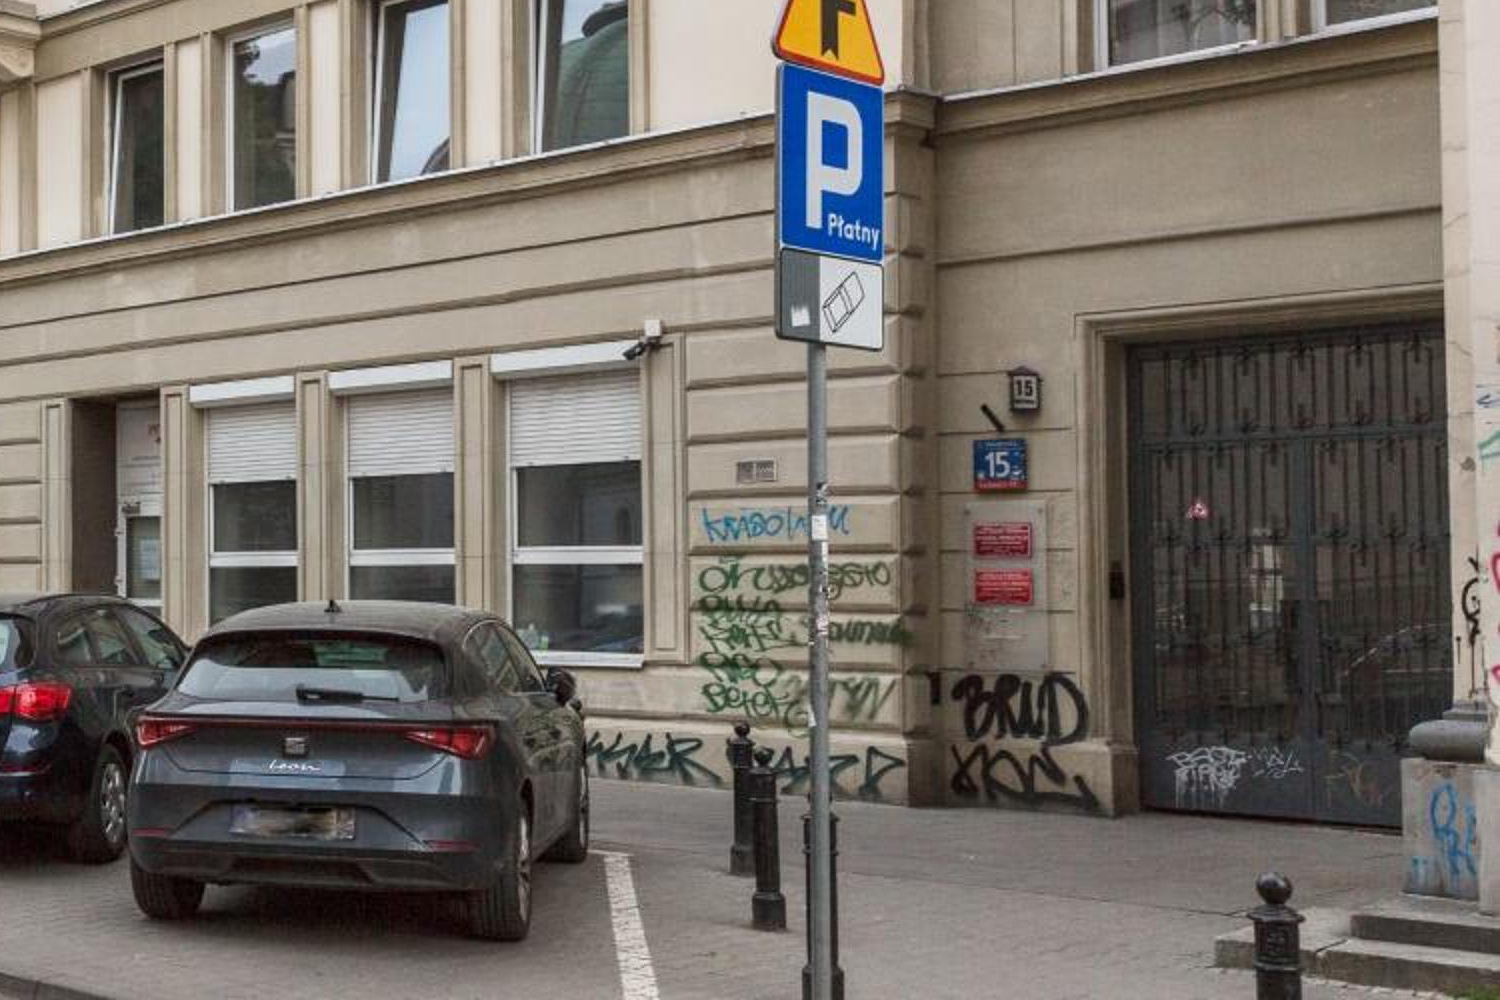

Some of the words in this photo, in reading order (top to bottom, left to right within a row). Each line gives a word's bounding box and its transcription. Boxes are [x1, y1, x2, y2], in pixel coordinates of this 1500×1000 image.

[805, 90, 863, 229] P
[827, 212, 881, 251] Płatny
[1015, 380, 1034, 397] 15
[985, 451, 1011, 478] 15
